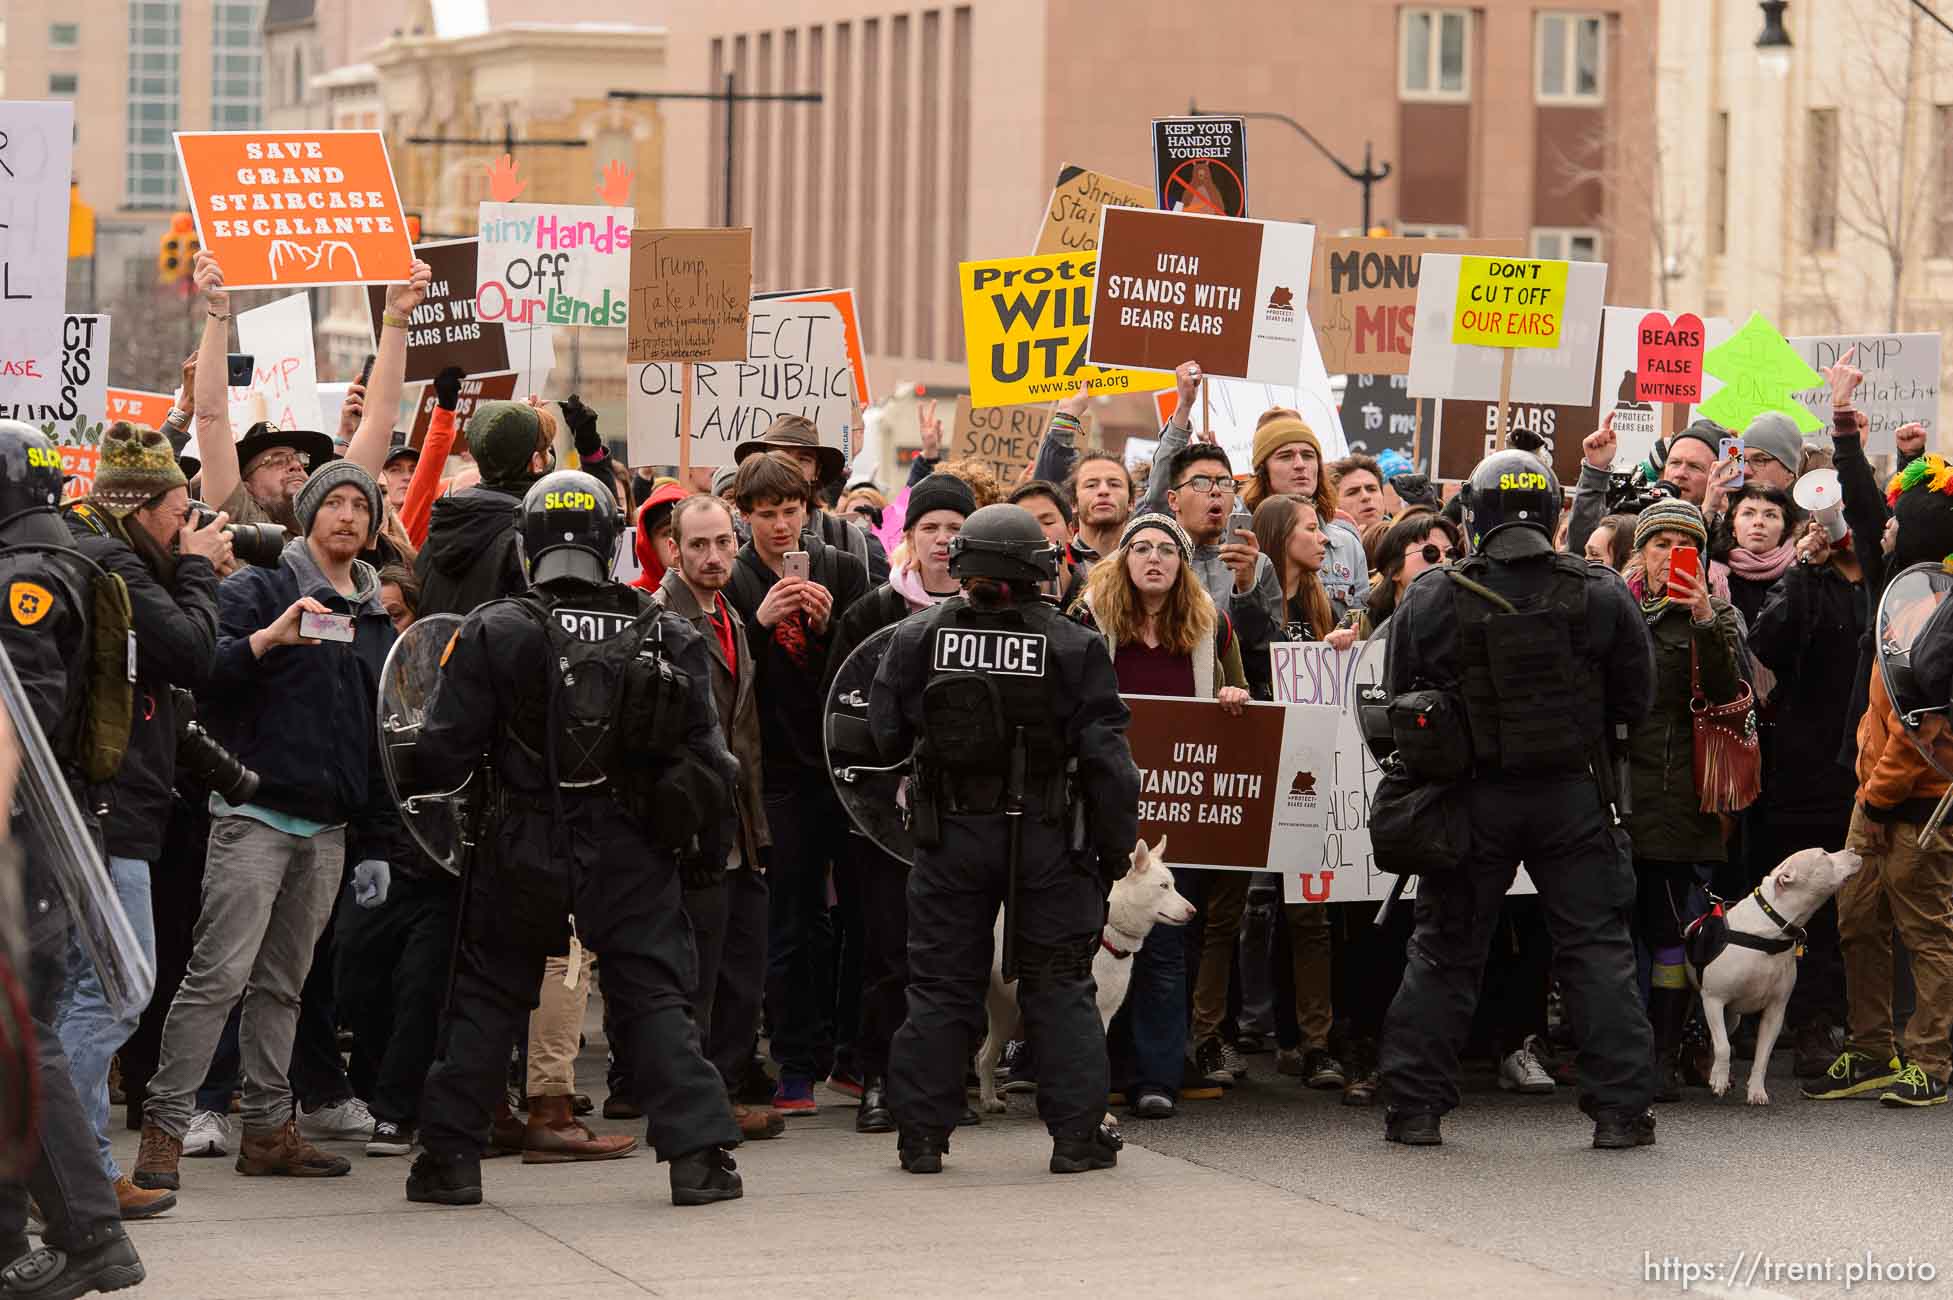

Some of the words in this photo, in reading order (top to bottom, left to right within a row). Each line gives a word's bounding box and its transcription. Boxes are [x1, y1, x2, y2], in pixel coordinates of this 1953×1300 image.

[1165, 124, 1195, 135] KEEP
[1197, 123, 1232, 134] YOUR
[1168, 136, 1211, 147] HANDS
[1213, 135, 1231, 146] TO
[246, 142, 323, 160] SAVE
[1168, 147, 1231, 158] YOURSELF
[237, 167, 345, 185] GRAND
[209, 192, 385, 212] STAIRCASE
[1079, 173, 1144, 206] Shrink
[1052, 195, 1099, 223] Stai
[213, 217, 395, 238] ESCALANTE
[482, 216, 535, 243] tiny
[536, 214, 632, 254] Hands
[1061, 227, 1098, 251] Wo
[506, 253, 570, 295] Off
[640, 236, 709, 297] Trump,
[974, 260, 1097, 290] Prote
[1157, 253, 1199, 275] UTAH
[1330, 250, 1422, 294] MONU
[1489, 262, 1541, 279] DON'T
[476, 281, 546, 324] Our
[546, 288, 627, 326] Lands
[632, 279, 683, 320] Take
[1108, 275, 1186, 305] STANDS
[1195, 283, 1241, 311] WITH
[1471, 285, 1514, 303] CUT
[1518, 288, 1551, 305] OFF
[991, 286, 1091, 333] WIL
[1120, 306, 1174, 330] BEARS
[1180, 312, 1223, 335] EARS
[406, 328, 441, 348] EARS
[446, 323, 481, 343] EARS
[1355, 304, 1416, 353] MIS
[1461, 310, 1502, 334] OUR
[1507, 313, 1555, 336] EARS
[1643, 329, 1699, 347] BEARS
[991, 337, 1098, 384] UTA
[1648, 359, 1692, 374] FALSE
[735, 364, 848, 400] PUBLIC
[1641, 383, 1697, 397] WITNESS
[675, 403, 821, 444] LAND
[969, 406, 1002, 430] GO
[1613, 422, 1634, 432] BEARS
[1637, 424, 1654, 433] EARS
[1618, 412, 1650, 422] PROTECT
[1500, 472, 1547, 490] SLCPD
[545, 492, 595, 510] SLCPD
[561, 614, 633, 641] POLI
[942, 632, 1038, 673] POLICE
[1173, 743, 1217, 764] UTAH
[1213, 773, 1261, 799] WITH
[1138, 801, 1190, 822] BEARS
[1198, 804, 1243, 825] EARS
[1322, 833, 1353, 870] OL
